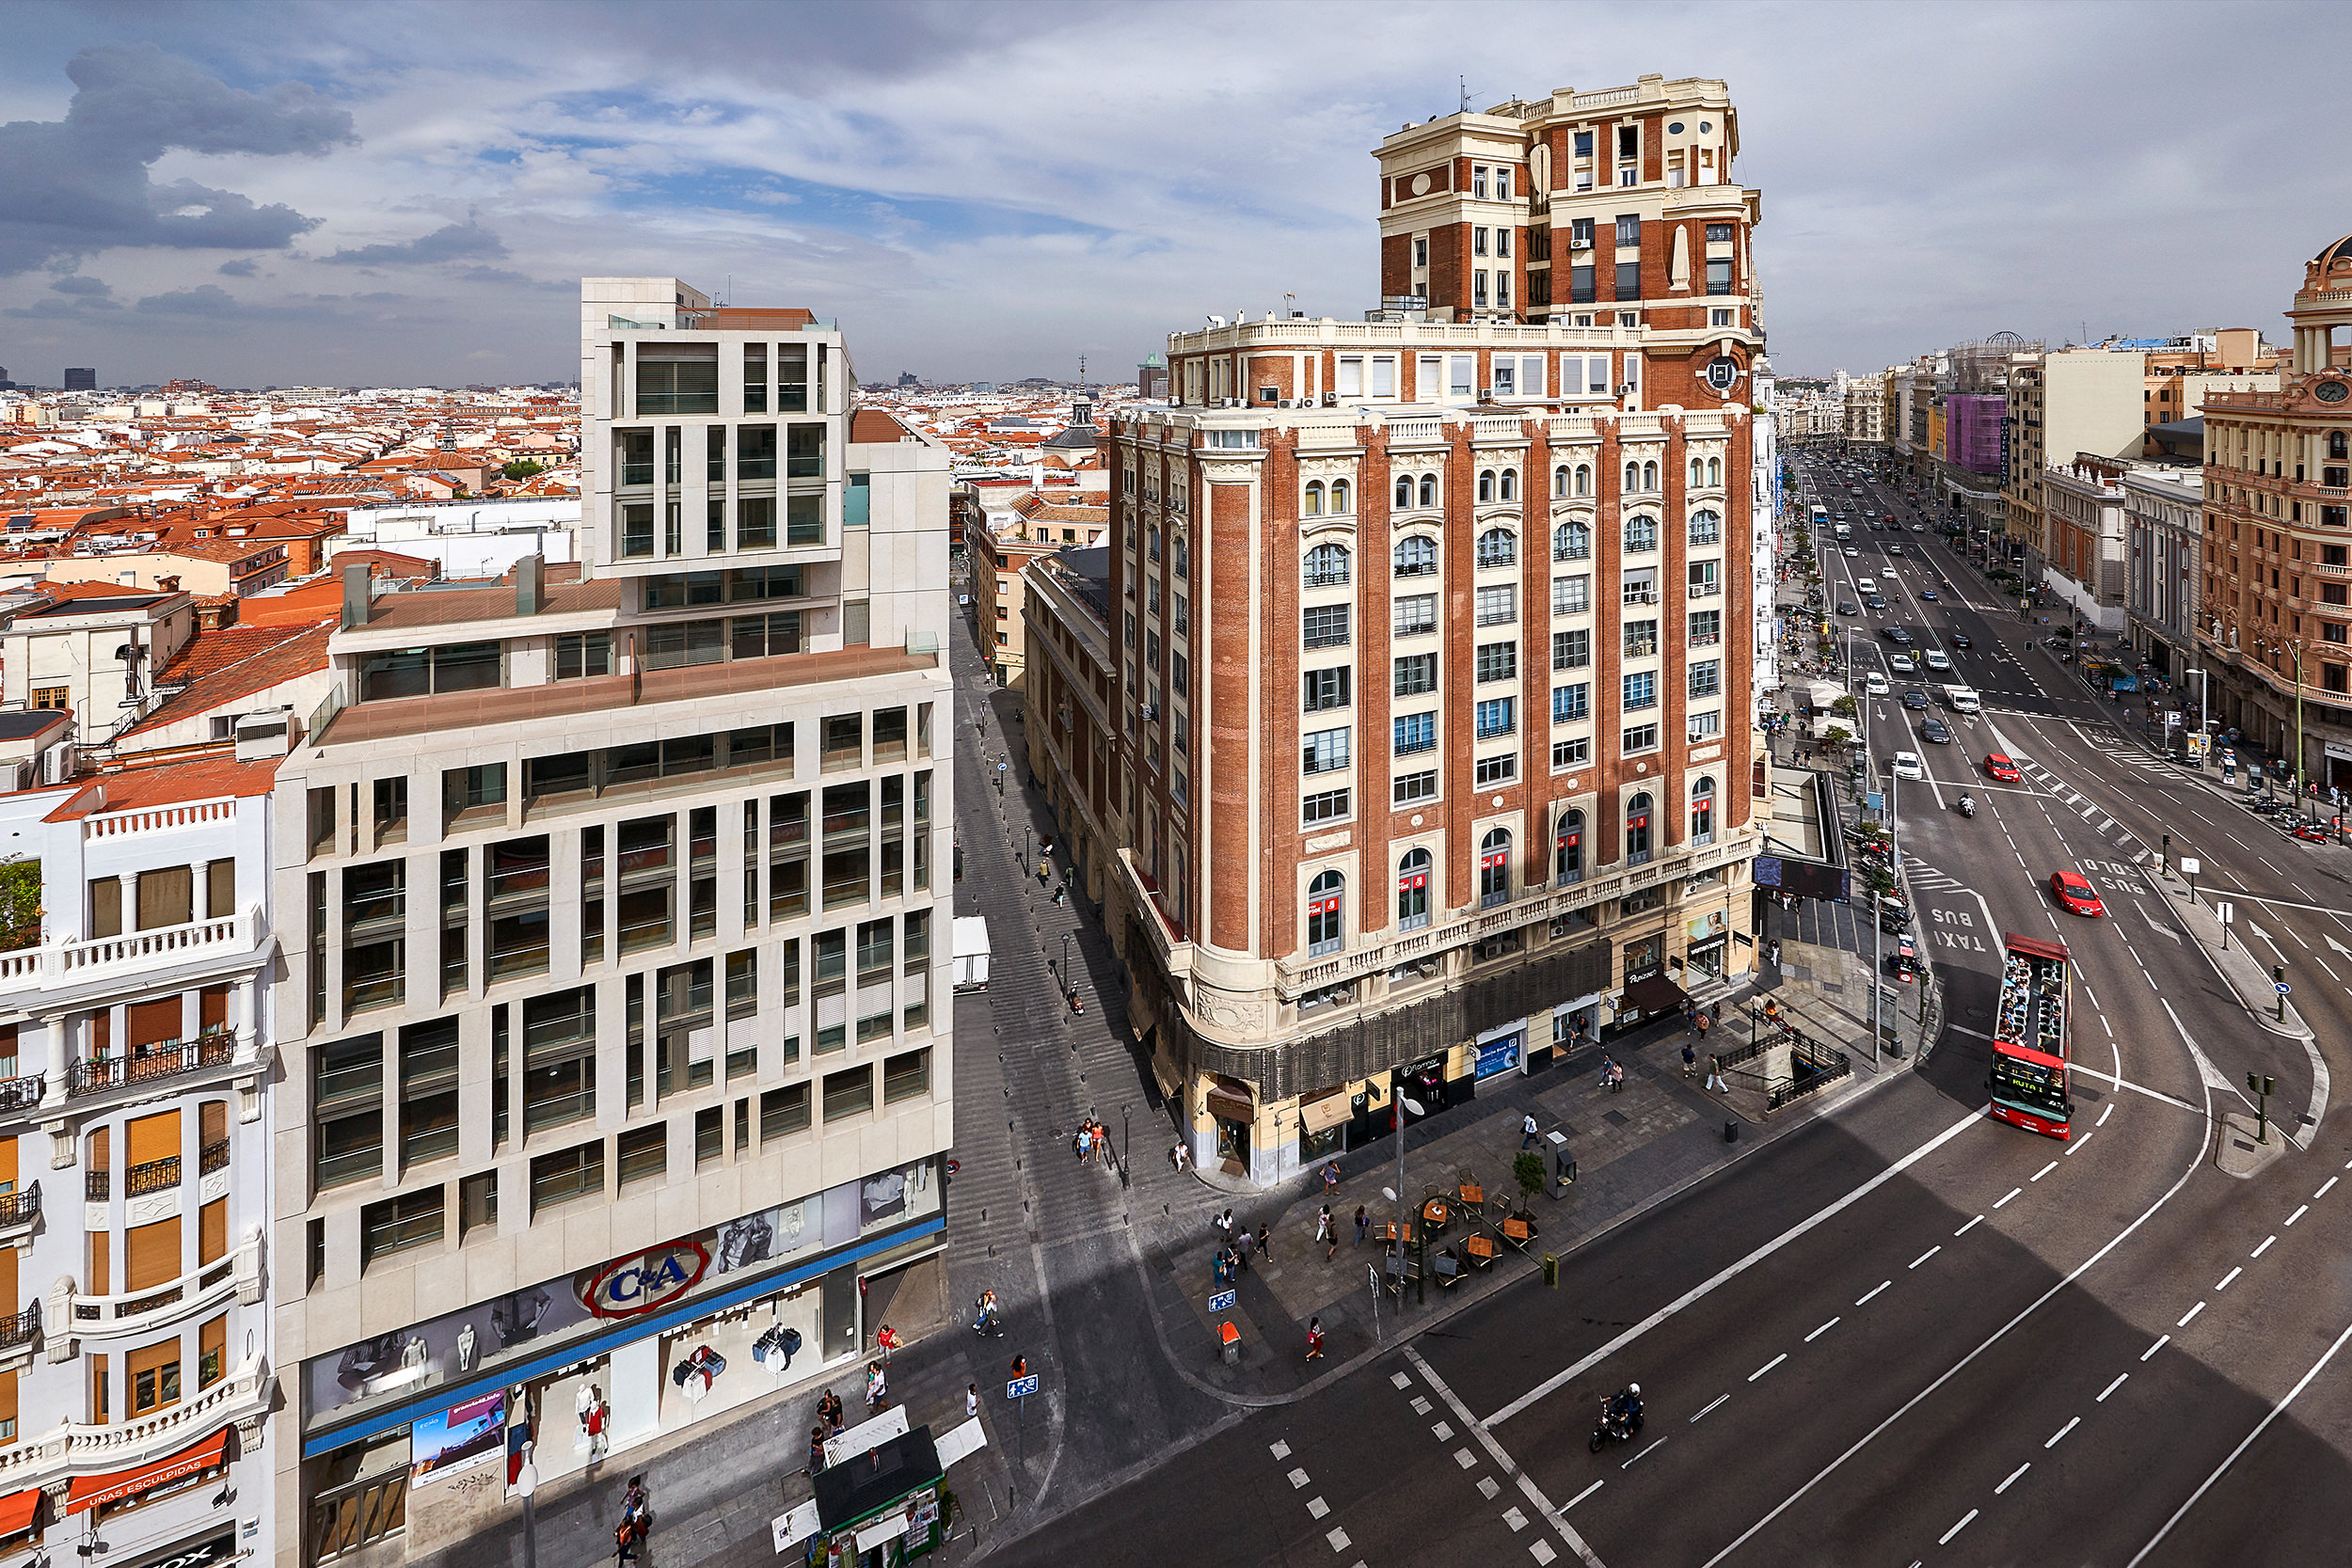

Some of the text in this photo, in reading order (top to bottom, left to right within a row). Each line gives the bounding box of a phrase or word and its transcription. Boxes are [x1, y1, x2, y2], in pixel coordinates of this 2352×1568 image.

[2000, 425, 2009, 485] HOTEL REGENTE
[2083, 858, 2140, 878] SOLO
[2100, 876, 2147, 895] BUS
[1931, 908, 1974, 927] BUS
[1933, 929, 1987, 953] TAXI
[2012, 1079, 2037, 1091] RUTA
[609, 1256, 688, 1302] C&A
[88, 1460, 202, 1507] UÑAS ESCULPIDAS
